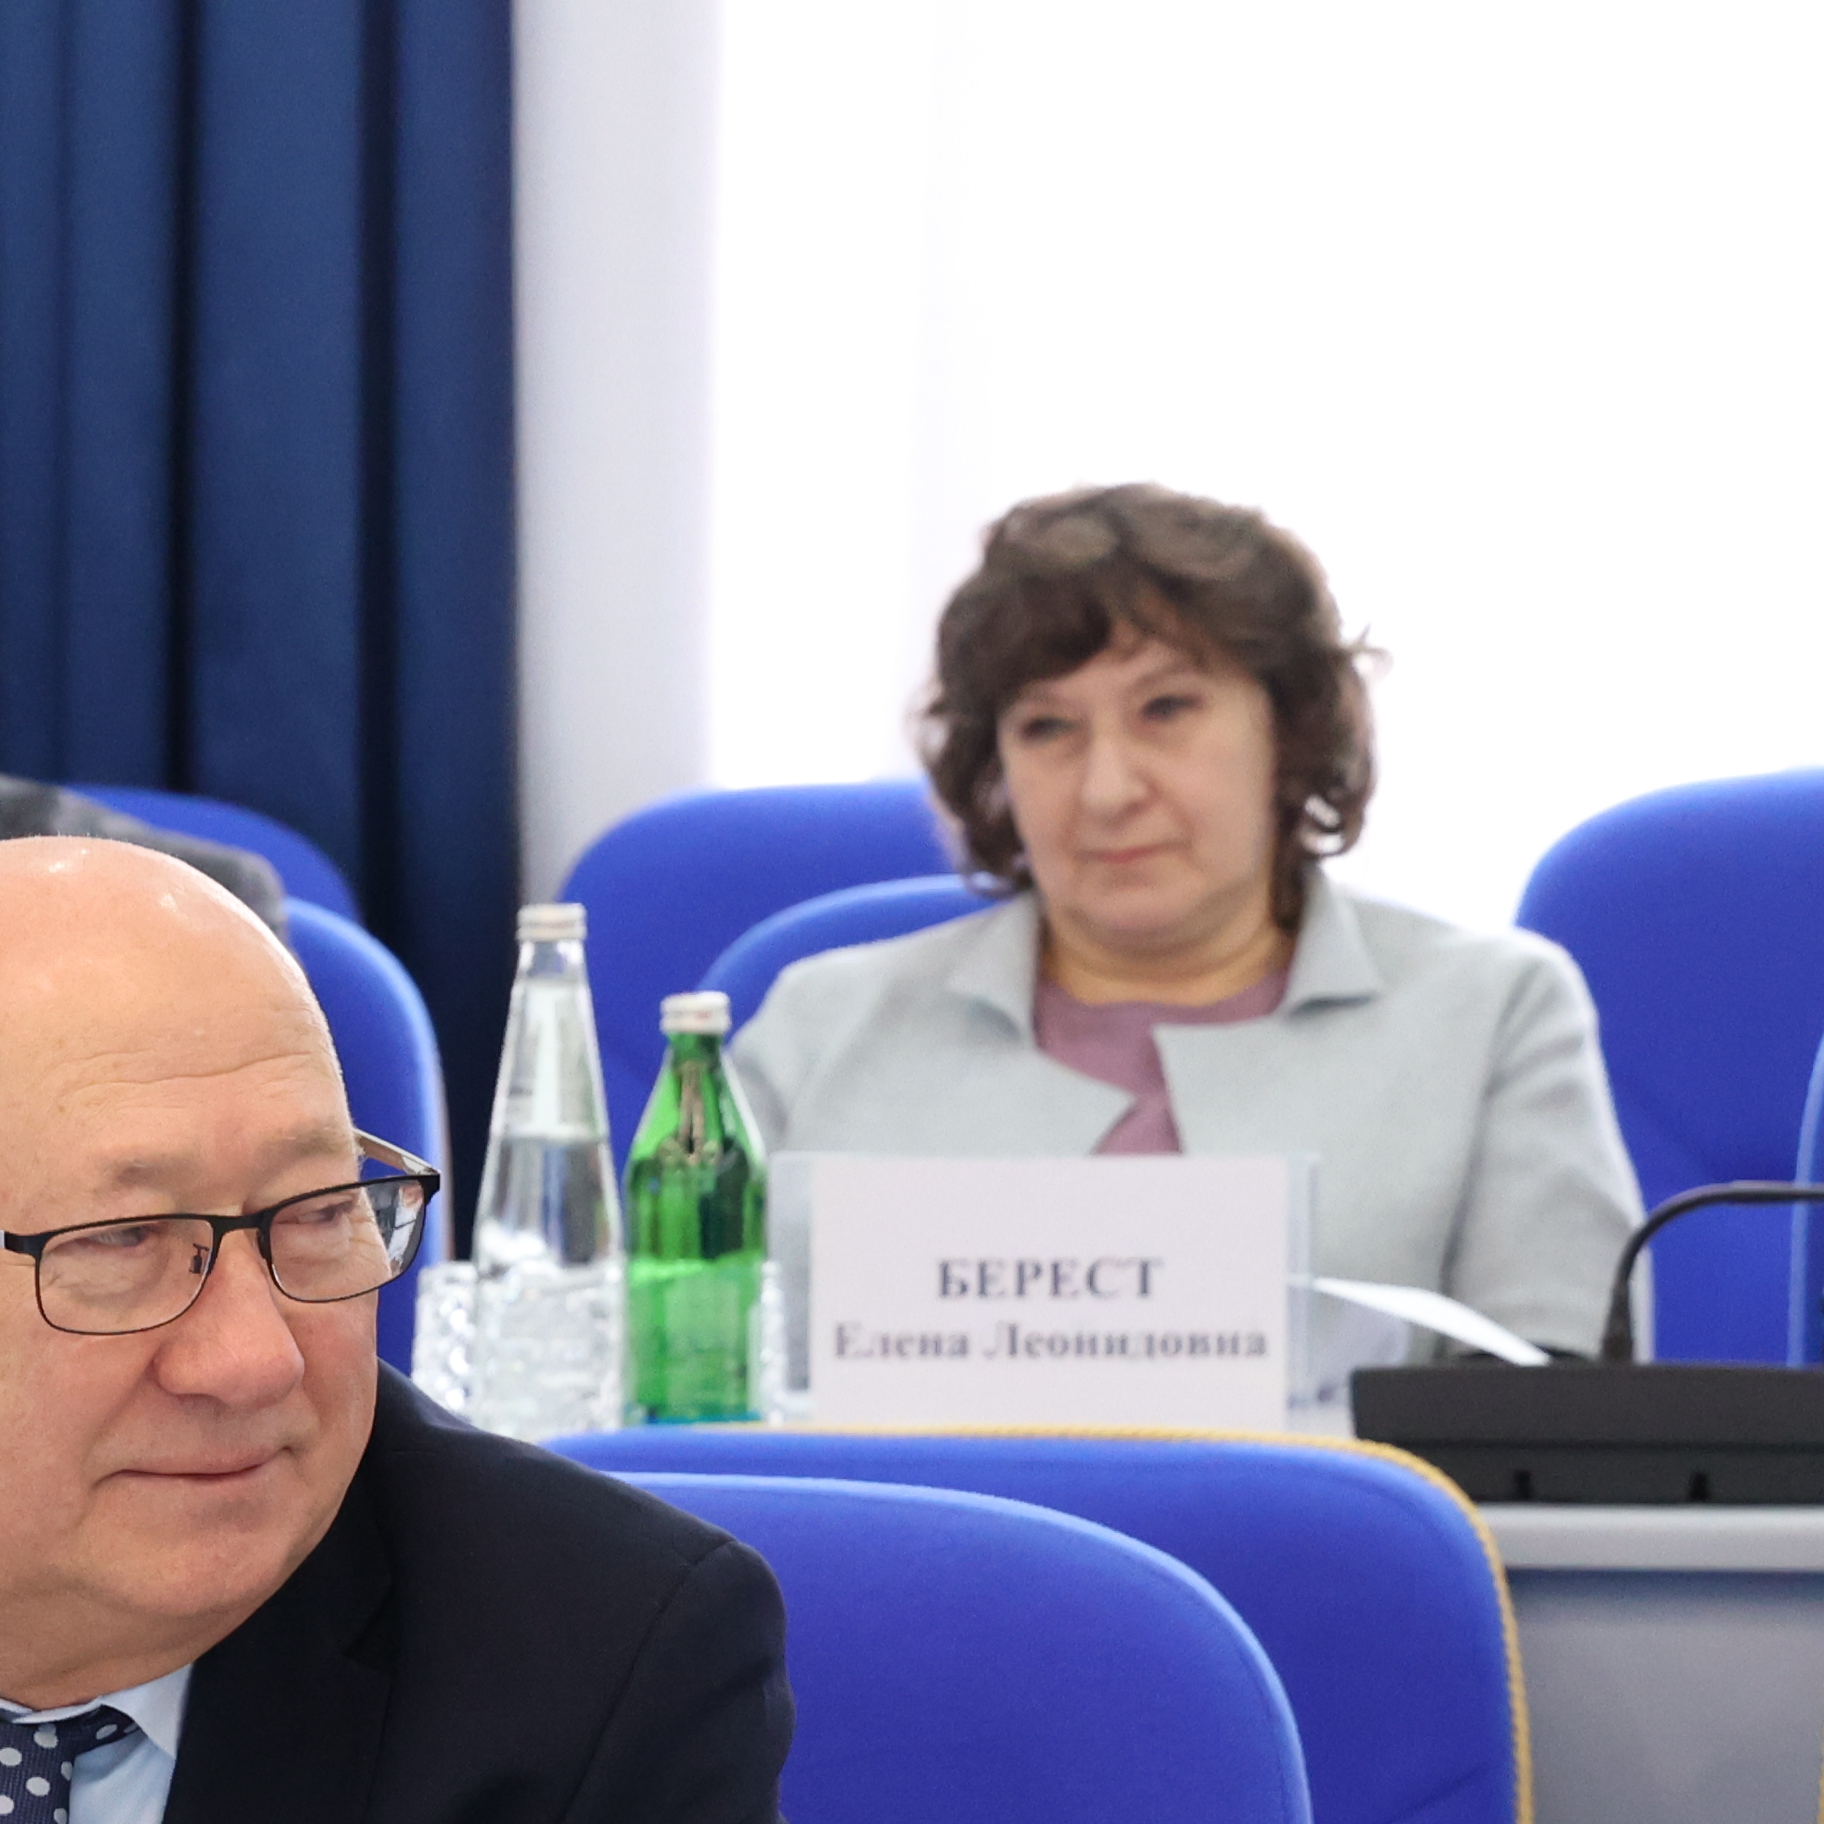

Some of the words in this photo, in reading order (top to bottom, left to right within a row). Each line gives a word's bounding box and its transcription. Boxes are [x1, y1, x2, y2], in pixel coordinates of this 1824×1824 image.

[937, 1257, 1162, 1300] БЕРЕСТ
[834, 1322, 969, 1359] Елена
[983, 1322, 1267, 1360] Леонидовна
